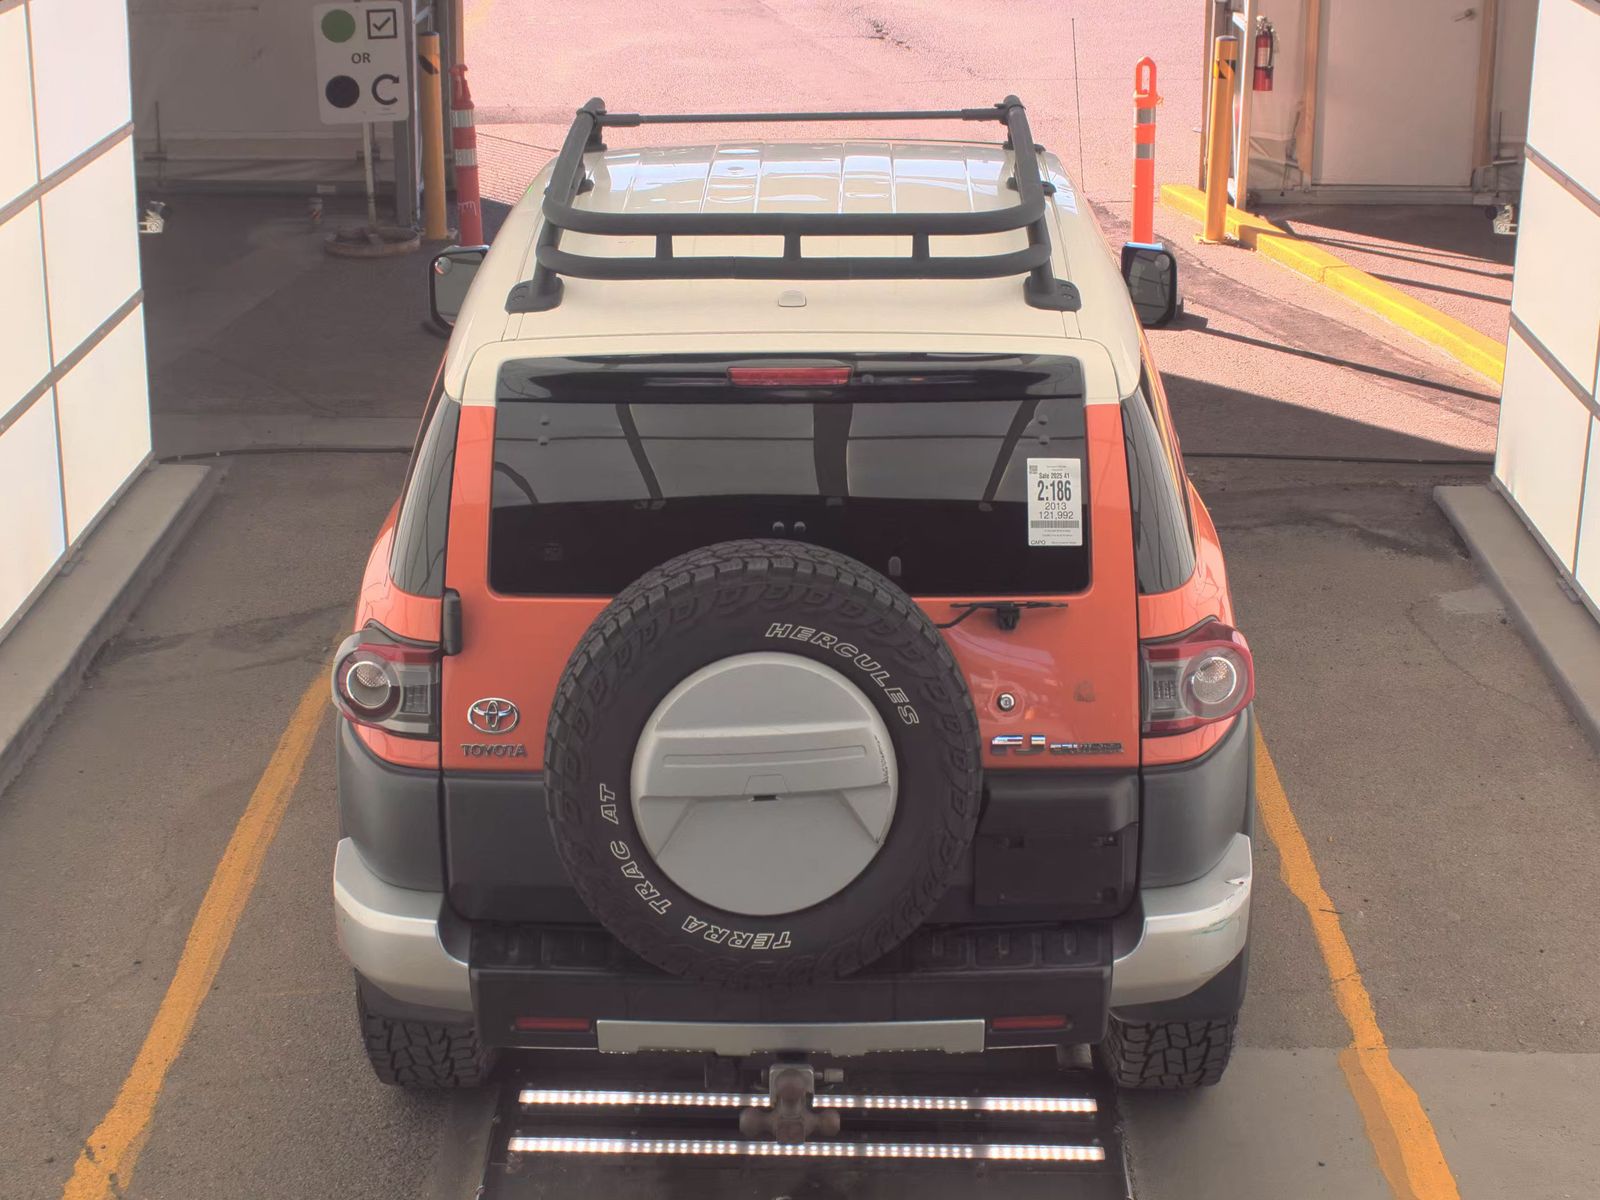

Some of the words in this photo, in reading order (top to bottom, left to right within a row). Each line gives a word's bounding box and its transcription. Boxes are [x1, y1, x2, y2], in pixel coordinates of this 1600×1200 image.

[351, 52, 371, 64] OR
[1037, 480, 1072, 501] 2:186
[1039, 511, 1074, 520] 121,992
[1045, 502, 1067, 511] 2013
[765, 622, 920, 725] HERCULES
[460, 743, 528, 757] TOYOTA
[599, 783, 619, 825] AT
[610, 840, 672, 915] TRAC
[681, 915, 792, 950] TERRA
